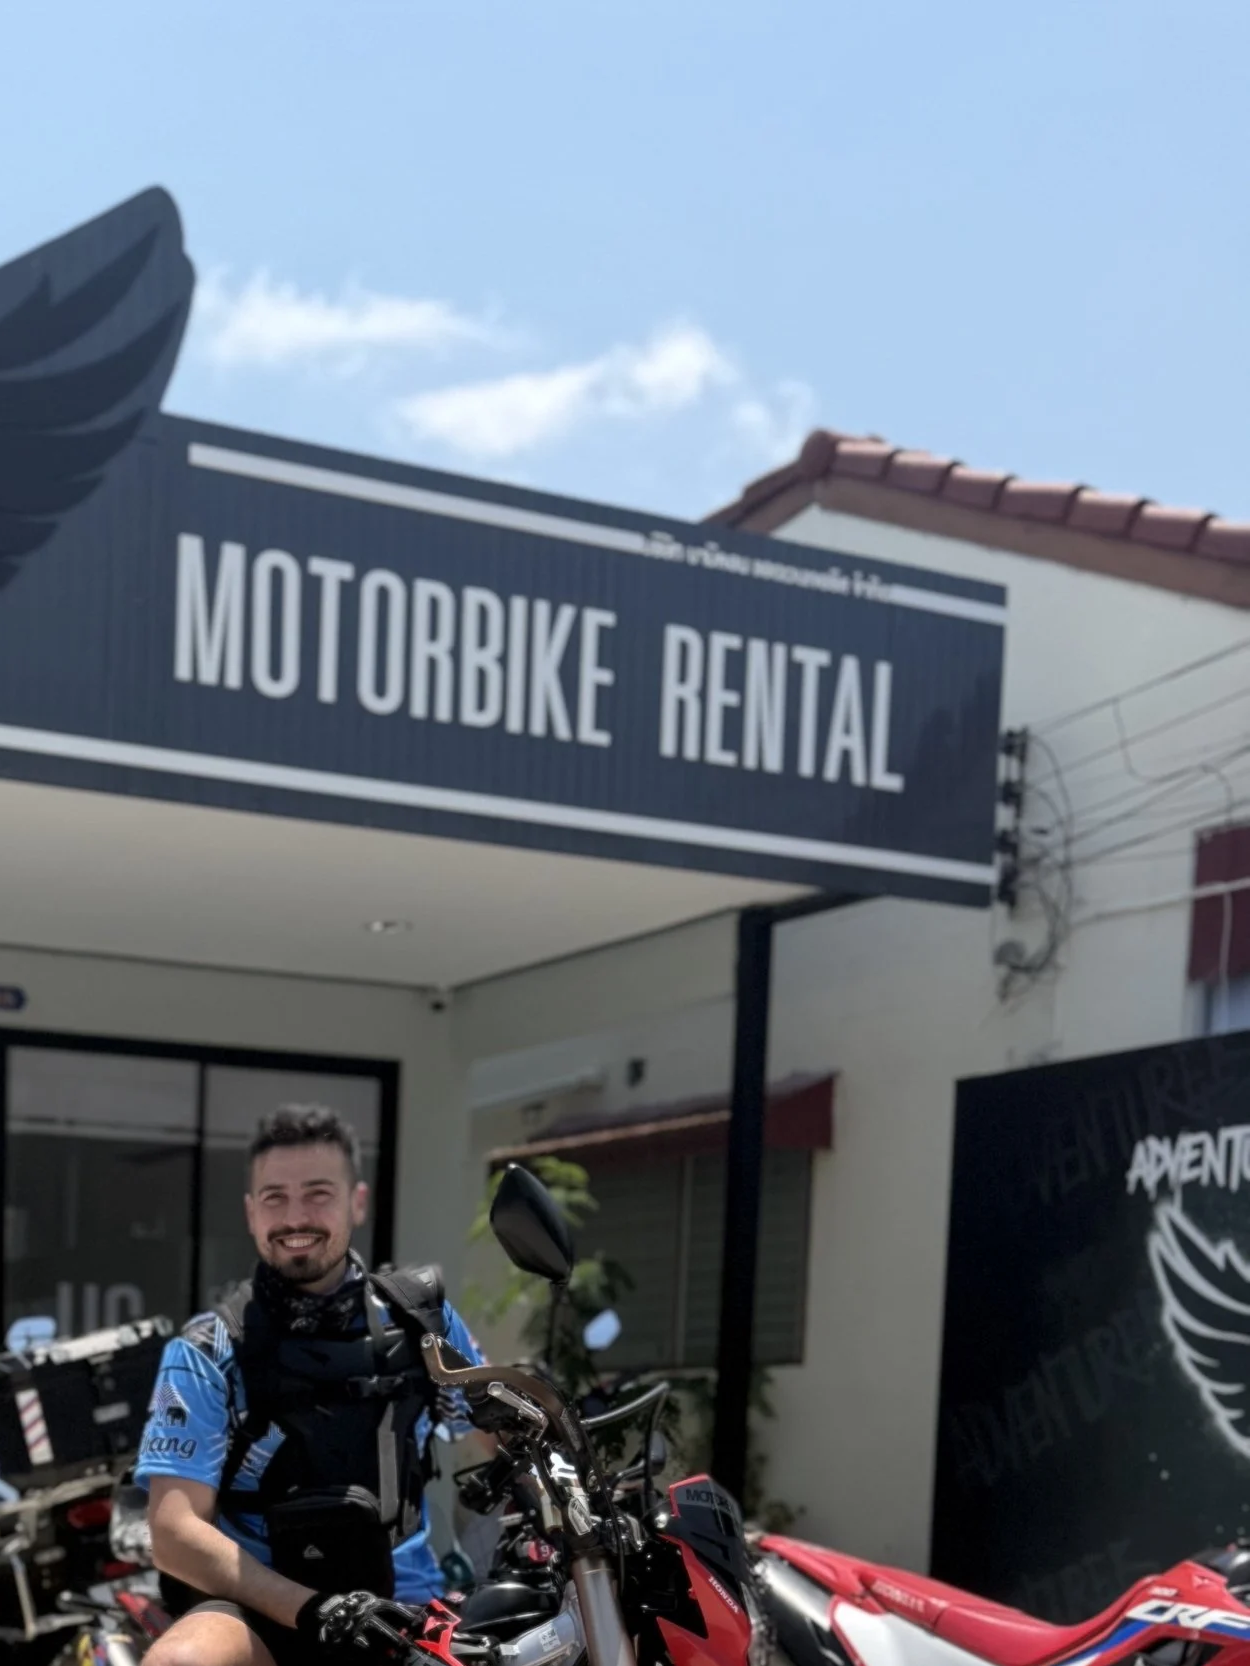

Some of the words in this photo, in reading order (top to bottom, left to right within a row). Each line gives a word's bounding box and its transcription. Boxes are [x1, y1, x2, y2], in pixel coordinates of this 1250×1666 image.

[174, 533, 618, 749] MOTORBIKE
[659, 624, 905, 793] RENTAL
[142, 1433, 198, 1460] ang
[708, 1575, 739, 1614] HONDA
[1125, 1598, 1250, 1630] CRF
